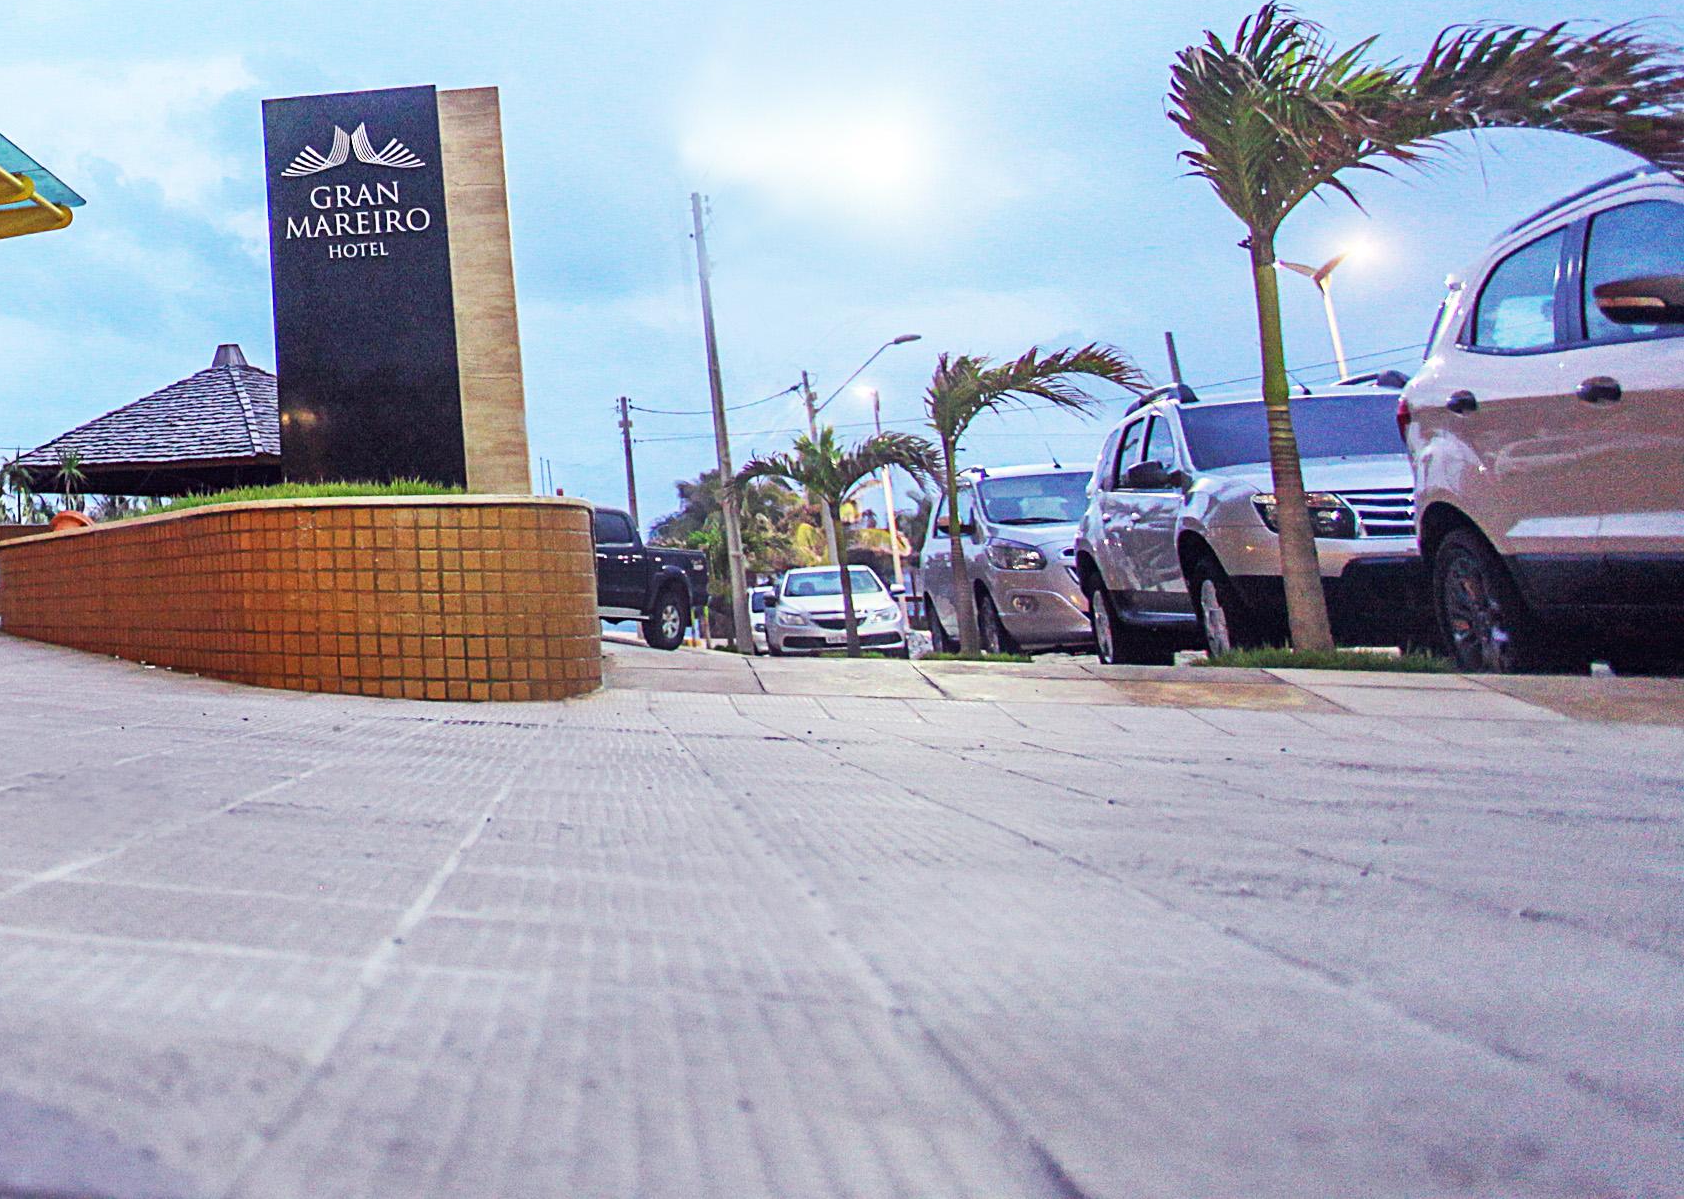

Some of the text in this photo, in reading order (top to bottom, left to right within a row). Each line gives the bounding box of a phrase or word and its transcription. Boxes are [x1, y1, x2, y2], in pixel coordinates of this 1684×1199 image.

[310, 181, 399, 209] GRAN
[286, 207, 430, 239] MAREIRO
[328, 242, 389, 259] HOTEL
